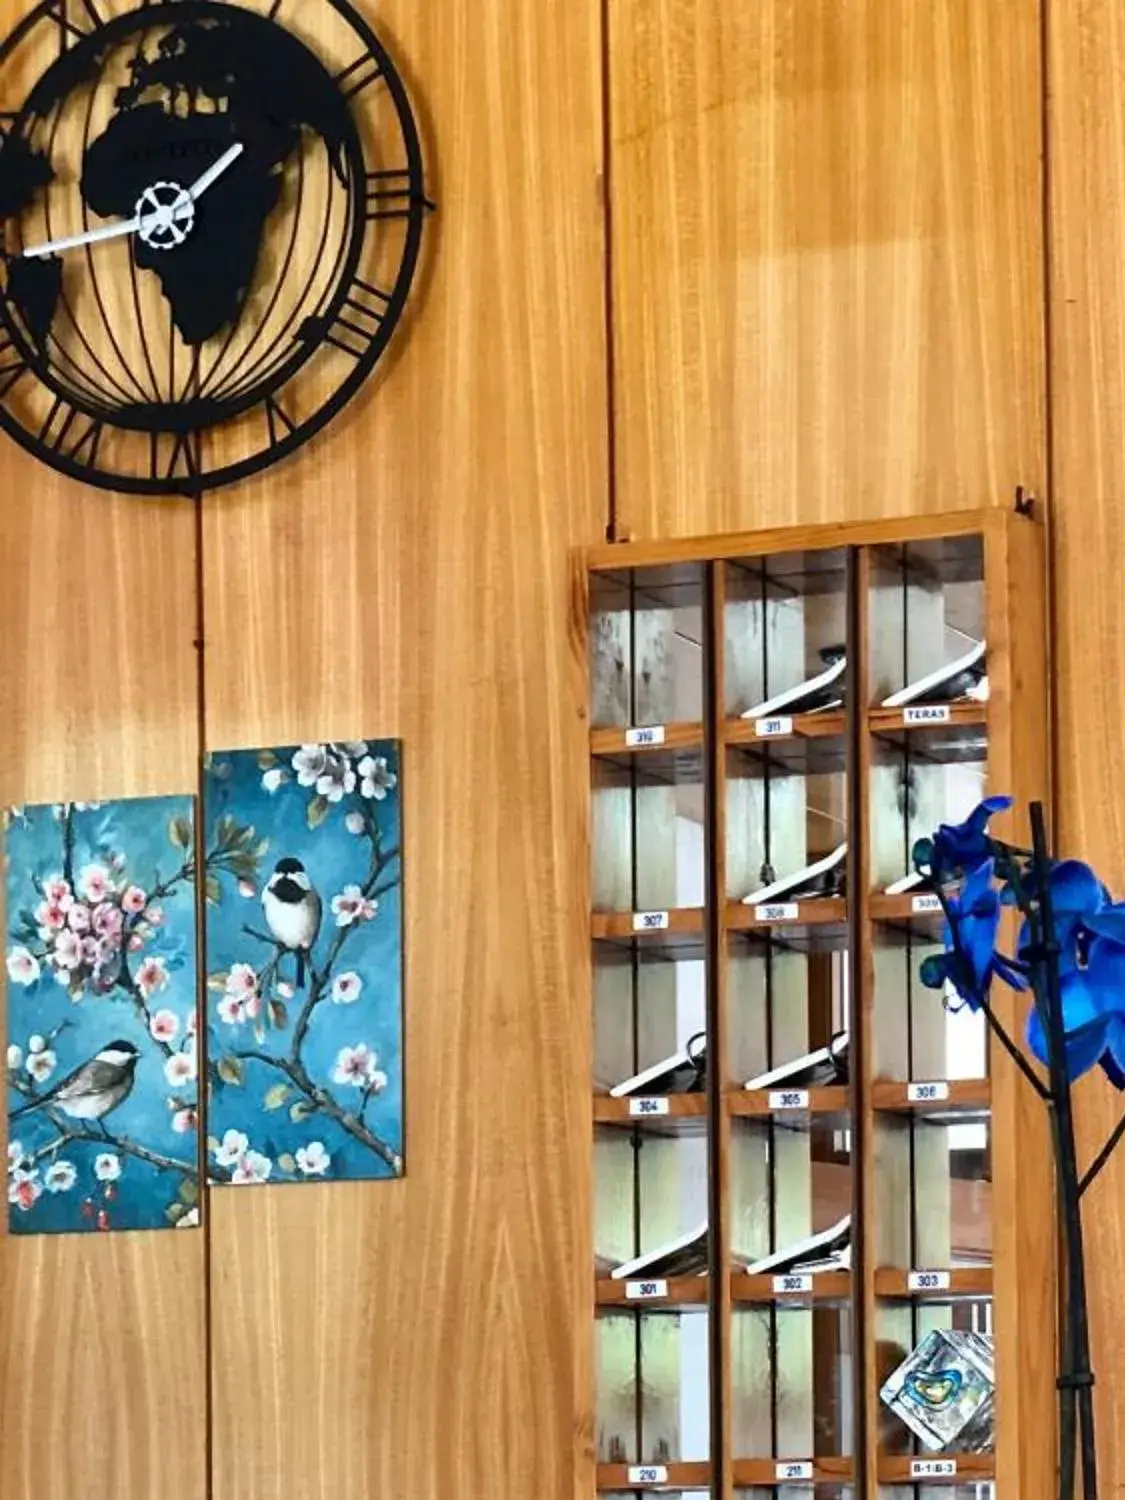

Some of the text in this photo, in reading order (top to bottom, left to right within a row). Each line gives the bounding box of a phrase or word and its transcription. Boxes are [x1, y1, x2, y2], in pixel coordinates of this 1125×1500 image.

[639, 1100, 658, 1112] 304
[783, 1277, 802, 1290] 302
[917, 1274, 939, 1287] 303
[639, 1283, 657, 1295] 301
